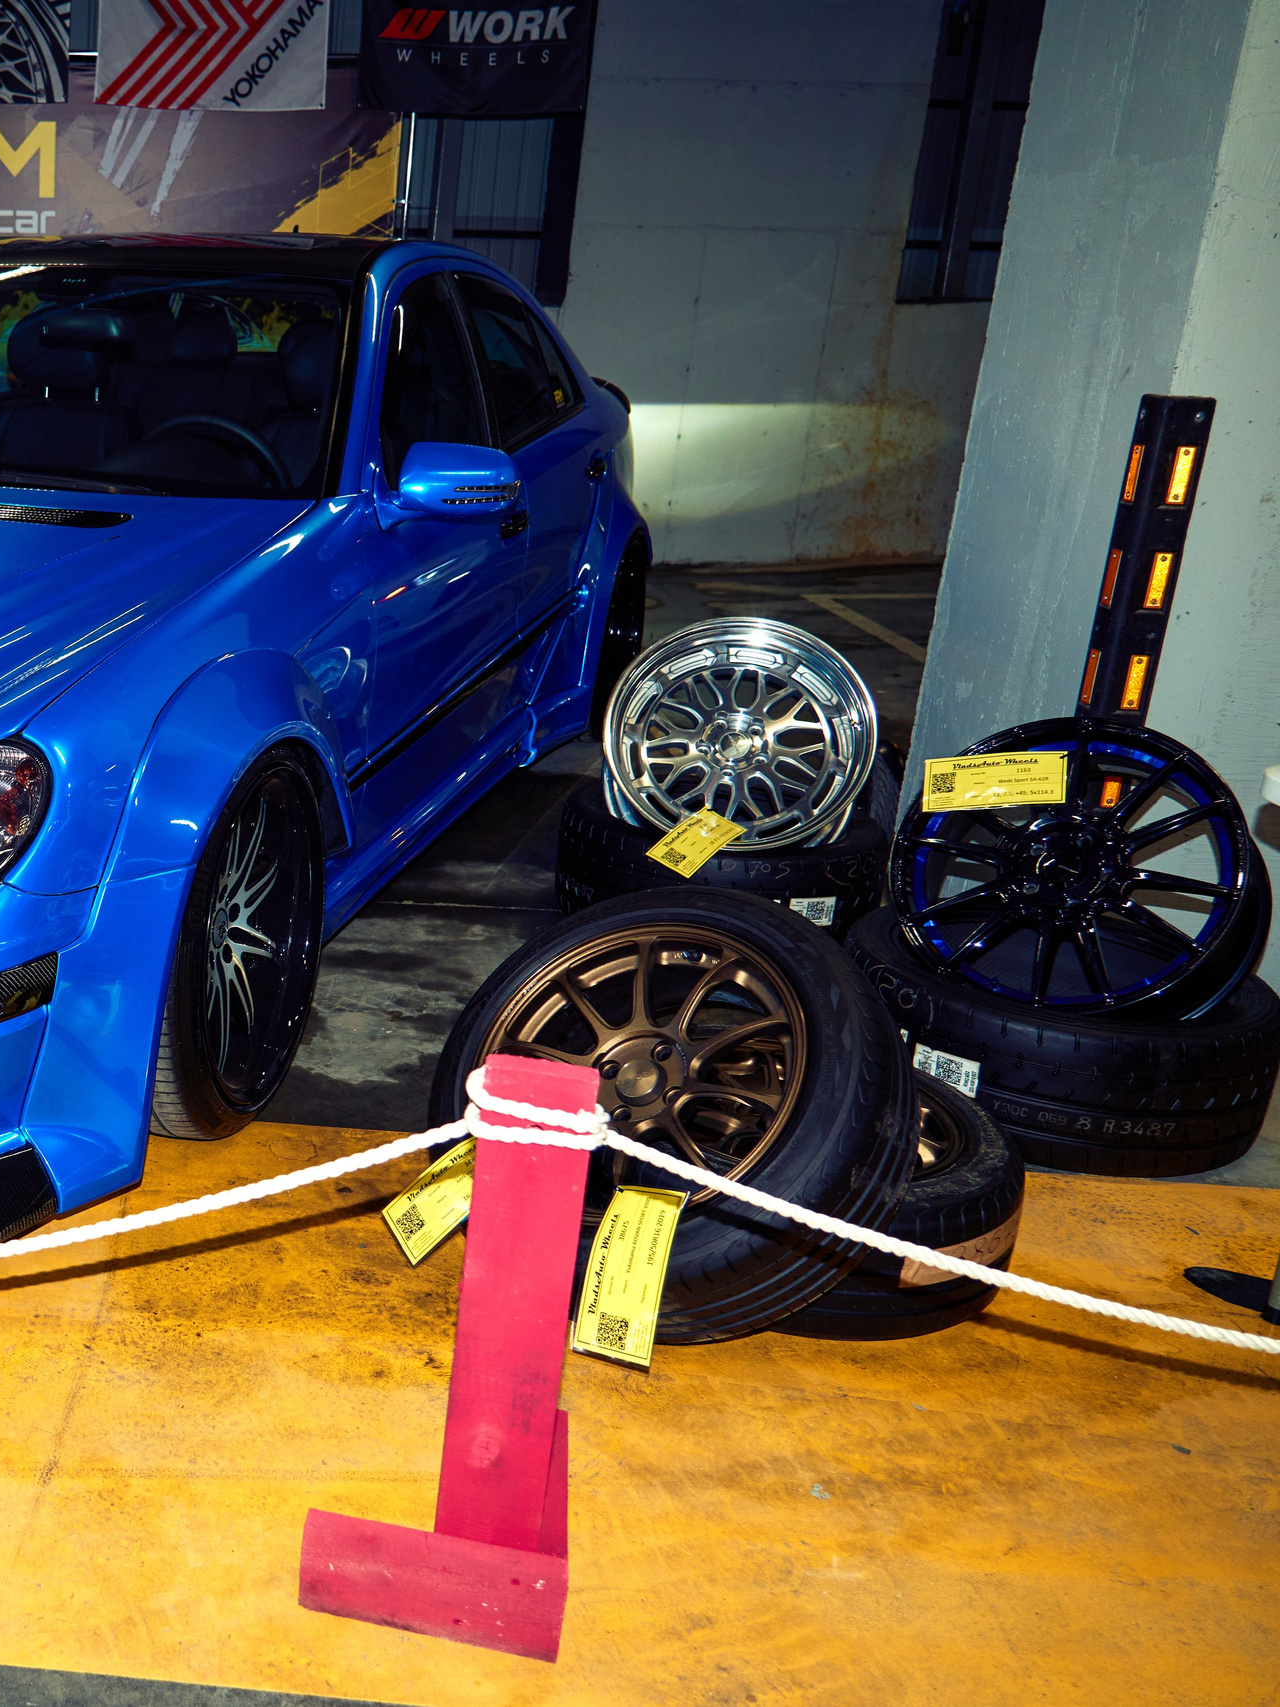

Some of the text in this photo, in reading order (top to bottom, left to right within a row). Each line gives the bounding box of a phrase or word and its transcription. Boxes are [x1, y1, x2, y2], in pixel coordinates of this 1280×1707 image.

[449, 6, 575, 43] WORK
[222, 0, 324, 107] YOKOHAMA
[397, 49, 550, 66] WHEELS
[1004, 757, 1038, 765] Wheels
[449, 1144, 477, 1165] Wheel
[600, 1212, 619, 1250] Wheels
[618, 1220, 630, 1241] 38675
[626, 1245, 636, 1274] Yokohama
[632, 1226, 642, 1246] ADVAN
[637, 1209, 647, 1226] SPORT
[646, 1228, 661, 1266] 195/50R16
[656, 1209, 666, 1227] 2019
